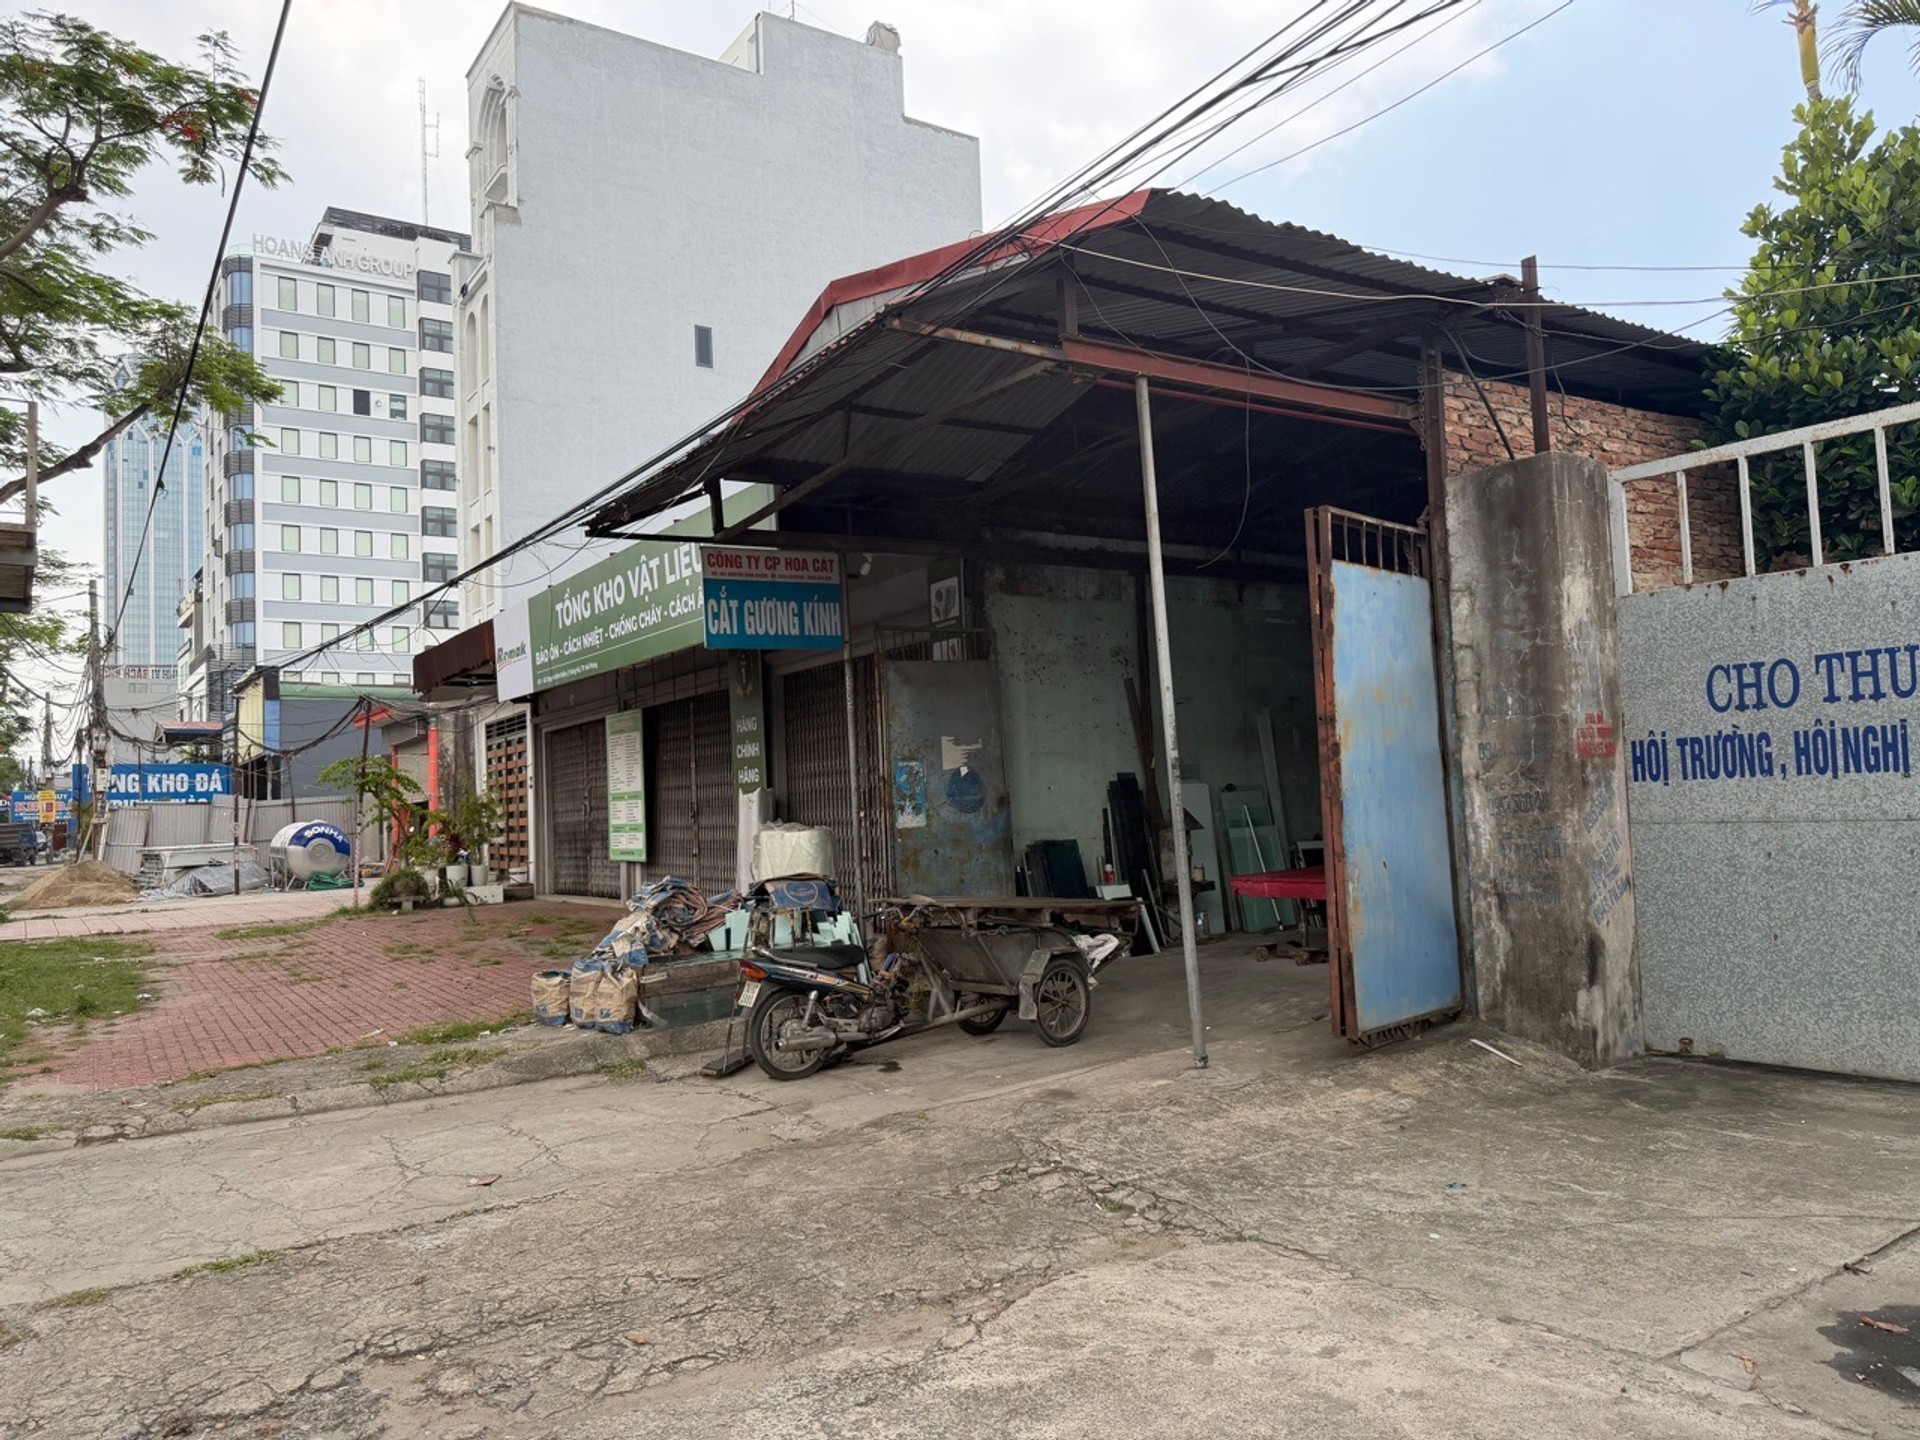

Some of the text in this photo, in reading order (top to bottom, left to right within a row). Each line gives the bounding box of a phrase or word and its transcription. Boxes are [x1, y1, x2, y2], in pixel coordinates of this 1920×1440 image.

[357, 255, 414, 279] GROUP
[707, 551, 743, 569] CÔNG
[746, 555, 760, 570] TY
[764, 556, 780, 571] CP
[555, 584, 592, 629] TỔNG
[593, 575, 625, 614] KHO
[627, 554, 660, 602] VẬT
[707, 585, 842, 636] CẮT GƯƠNG KÍNH
[563, 636, 582, 656] CÁCH
[582, 626, 603, 648] NHIỆT
[609, 613, 638, 639] CHỐNG
[639, 603, 662, 628] CHÁY
[669, 593, 695, 618] CÁCH
[1706, 658, 1800, 713] CHO
[736, 740, 760, 759] CHÍNH
[147, 773, 189, 793] KHO
[195, 768, 223, 793] ĐÁ
[304, 826, 344, 842] SONHA
